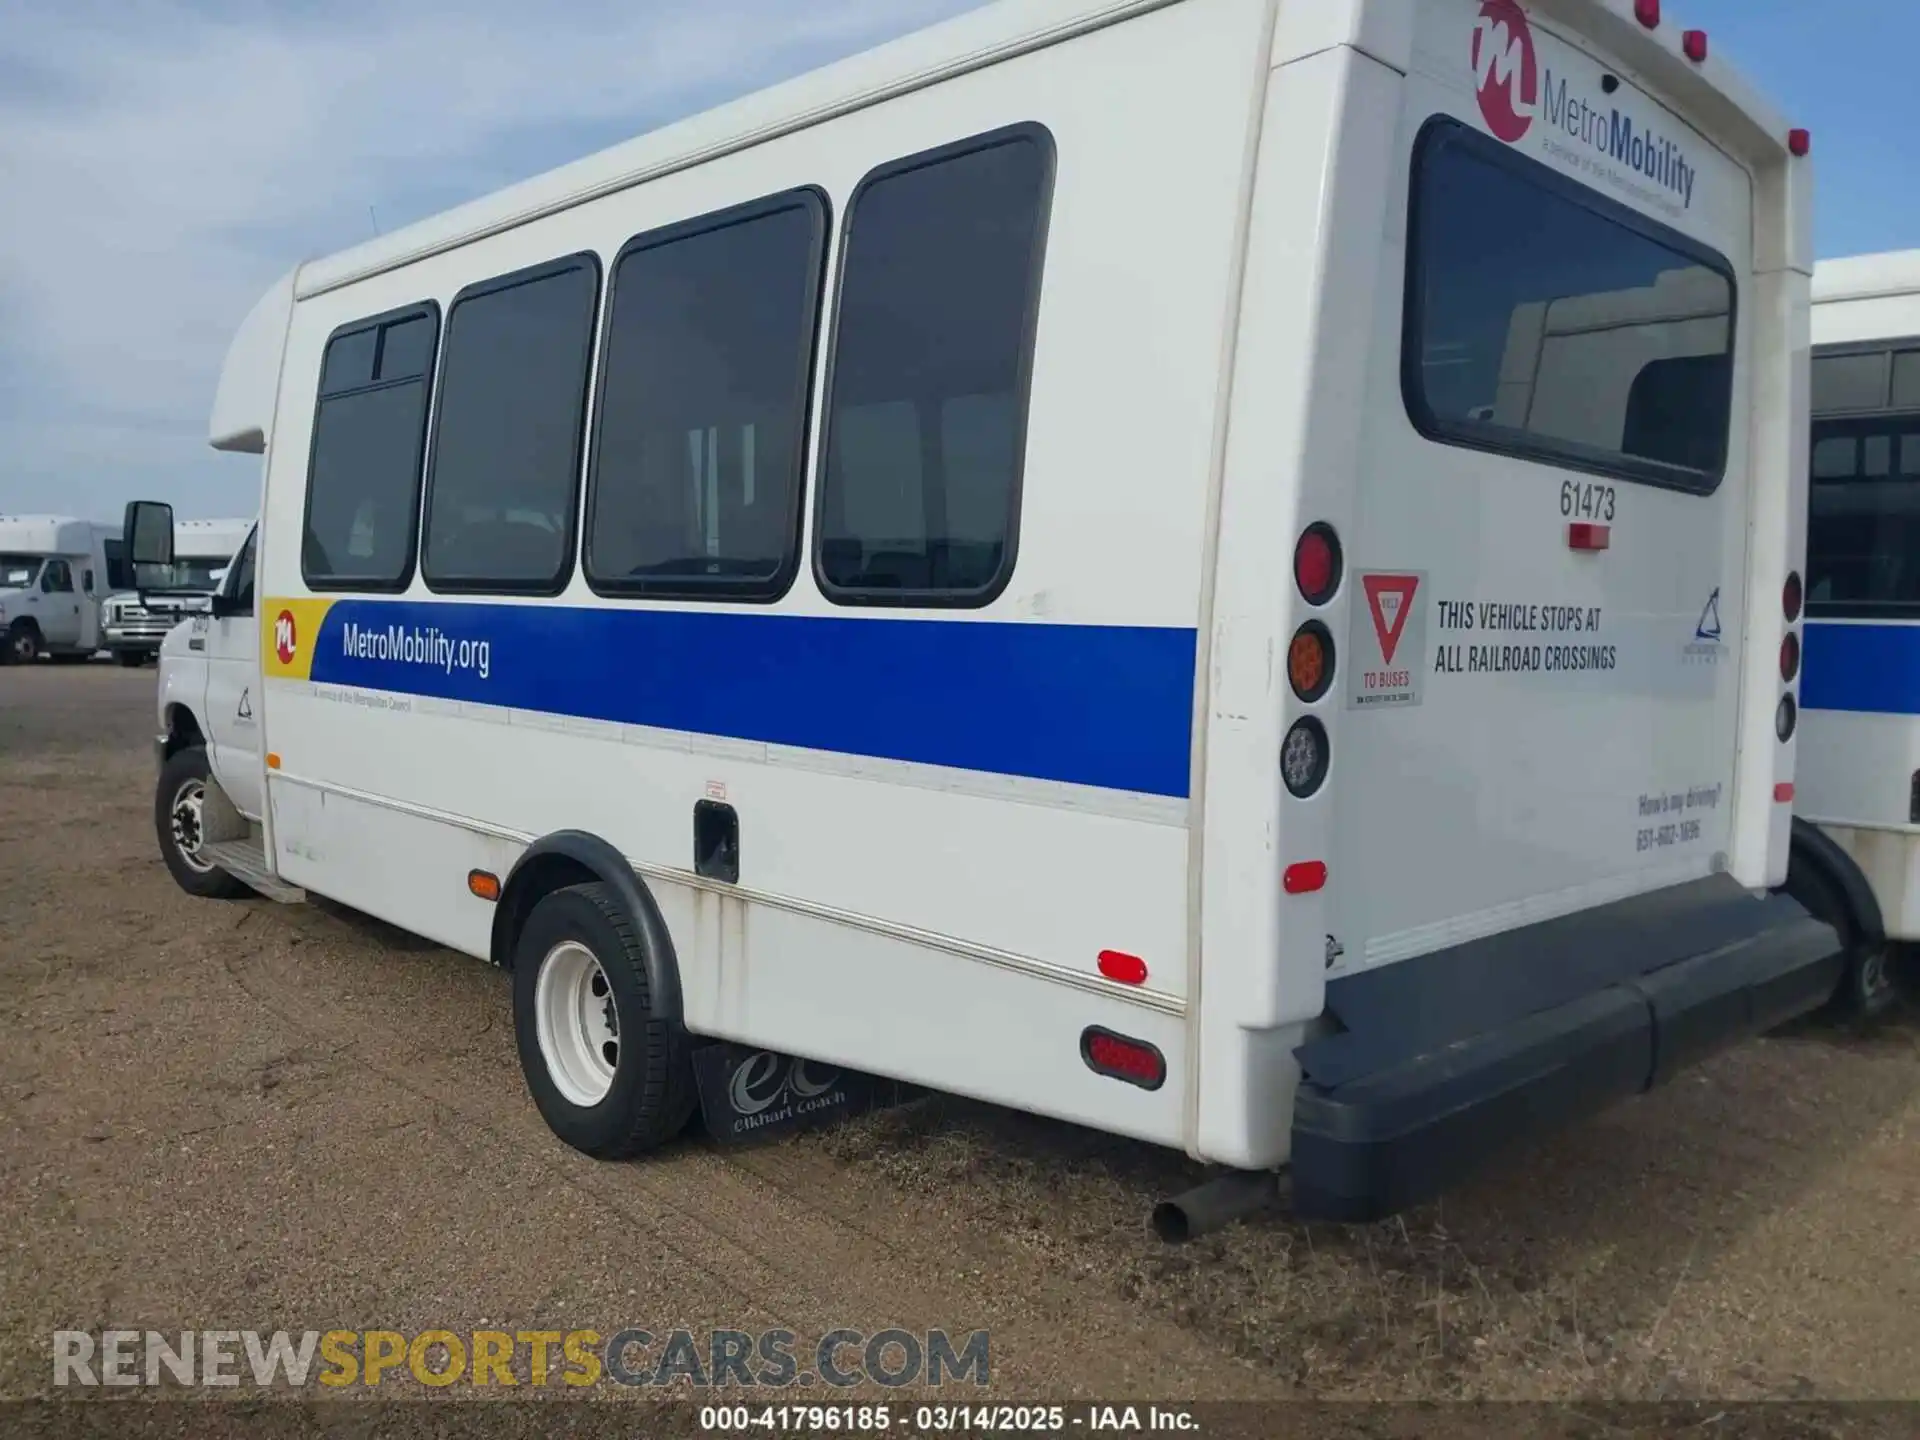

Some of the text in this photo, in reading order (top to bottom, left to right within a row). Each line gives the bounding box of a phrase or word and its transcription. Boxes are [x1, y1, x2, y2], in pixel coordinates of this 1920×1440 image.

[1544, 69, 1694, 208] MetroMobility
[1560, 481, 1615, 521] 61473
[1438, 601, 1601, 631] THIS VEHICLE STOPS AT
[343, 622, 489, 678] MetroMobility.org
[1435, 645, 1616, 672] ALL RAILROAD CROSSINGS
[1363, 671, 1410, 689] TO BUSES
